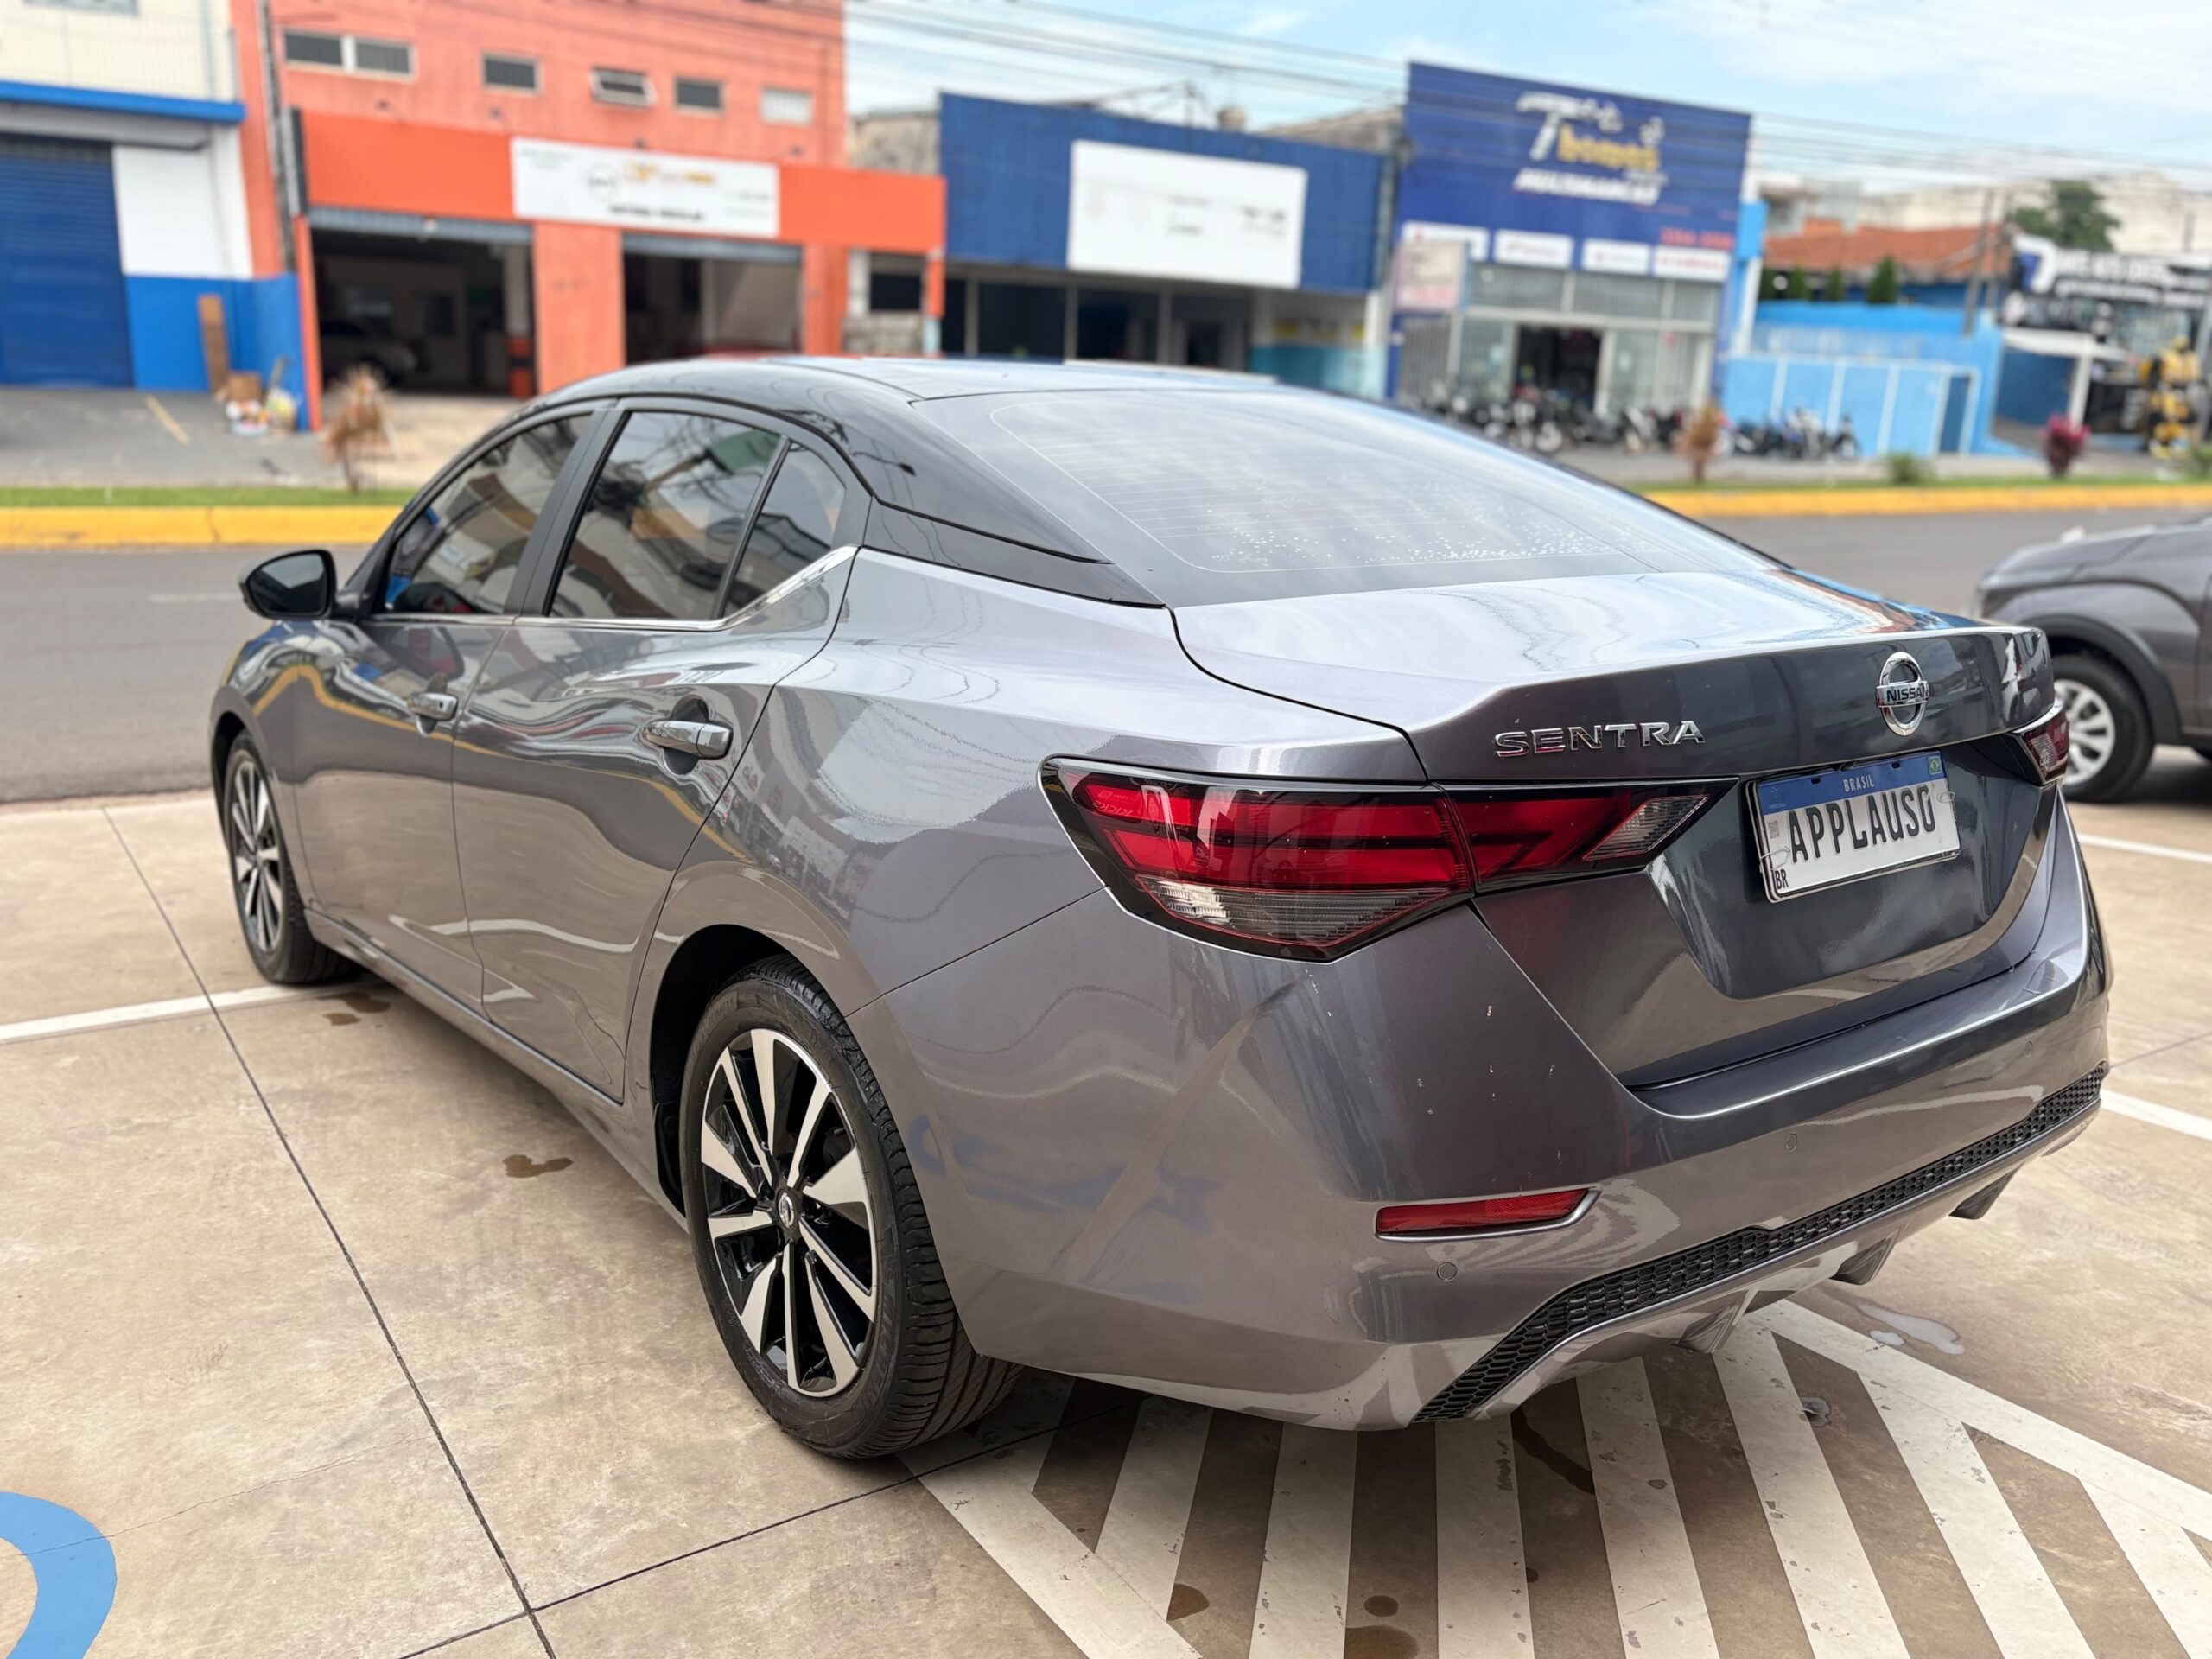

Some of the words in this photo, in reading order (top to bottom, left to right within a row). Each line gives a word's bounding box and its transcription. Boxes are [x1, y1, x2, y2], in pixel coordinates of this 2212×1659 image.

[1886, 686, 1928, 702] NISSAN
[1494, 720, 1707, 757] SENTRA
[1843, 774, 1875, 793] BRASIL
[1789, 785, 1936, 863] APPLAUSO
[1775, 868, 1789, 890] BR
